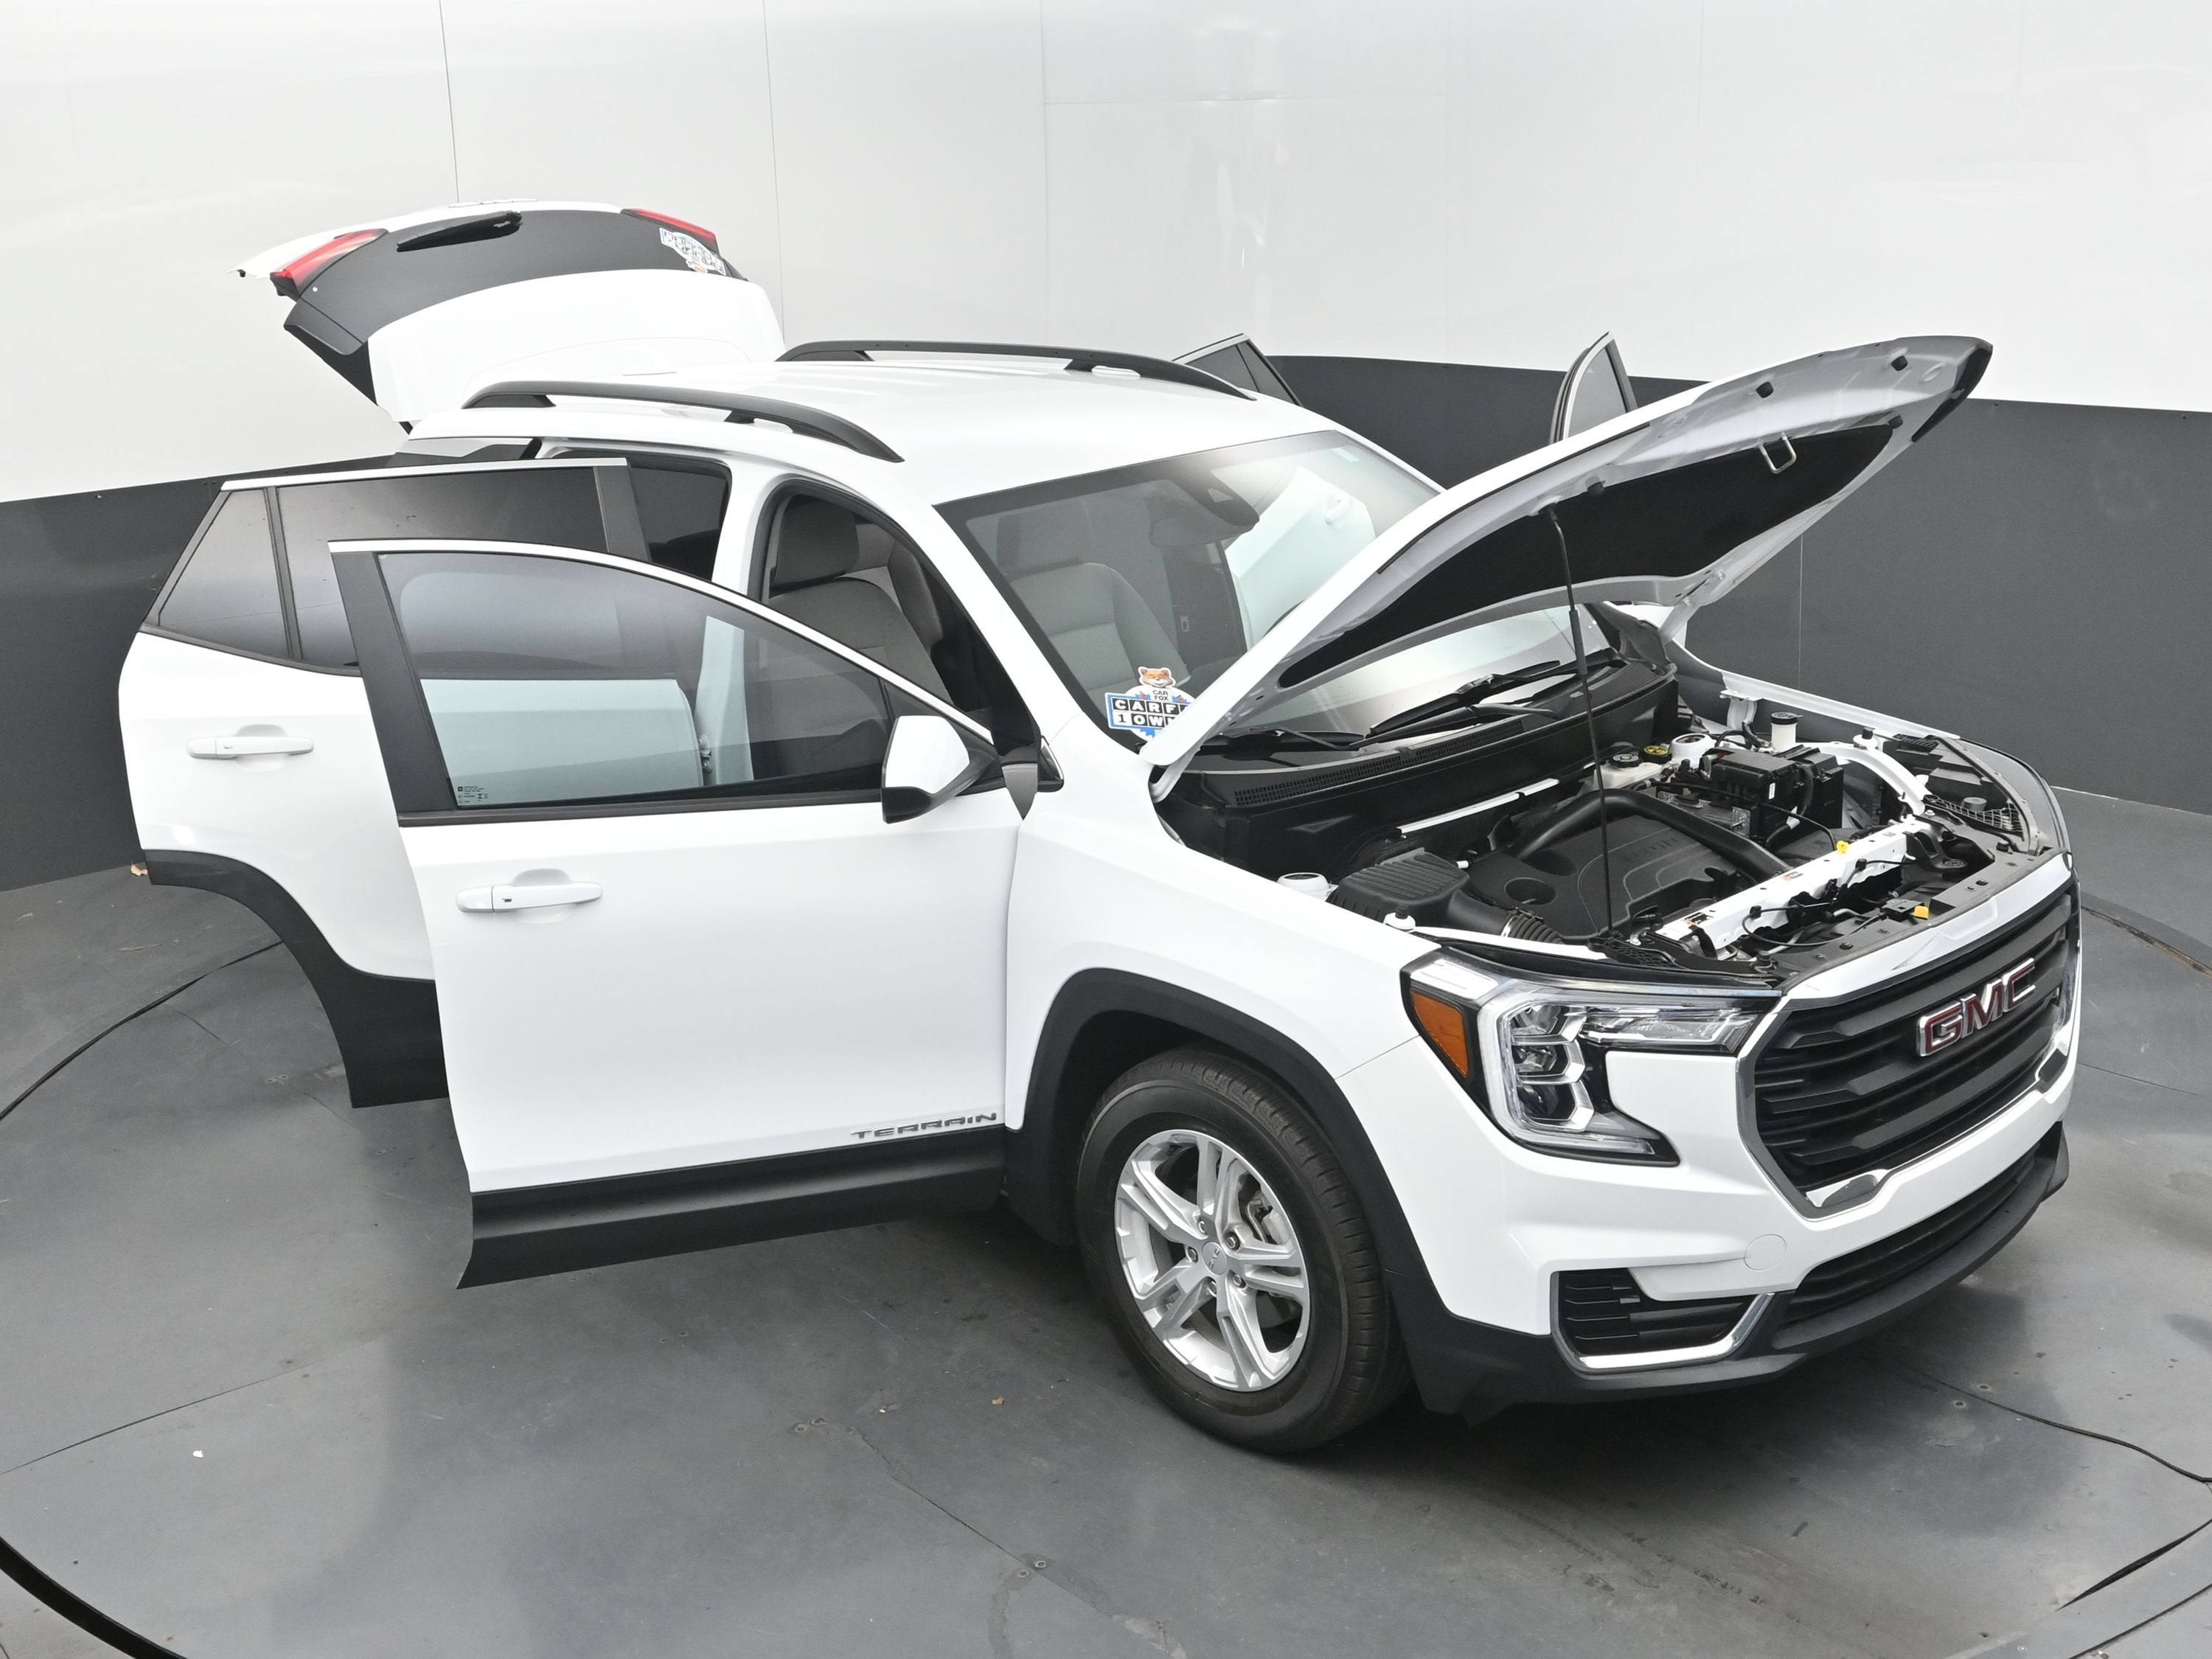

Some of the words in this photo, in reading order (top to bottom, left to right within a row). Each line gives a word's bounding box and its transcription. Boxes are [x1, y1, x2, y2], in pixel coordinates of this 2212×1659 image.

[1114, 699, 1180, 714] CARF
[1118, 714, 1127, 723] 1
[1919, 958, 2036, 1057] GMC
[850, 1113, 997, 1138] TERRAIN
